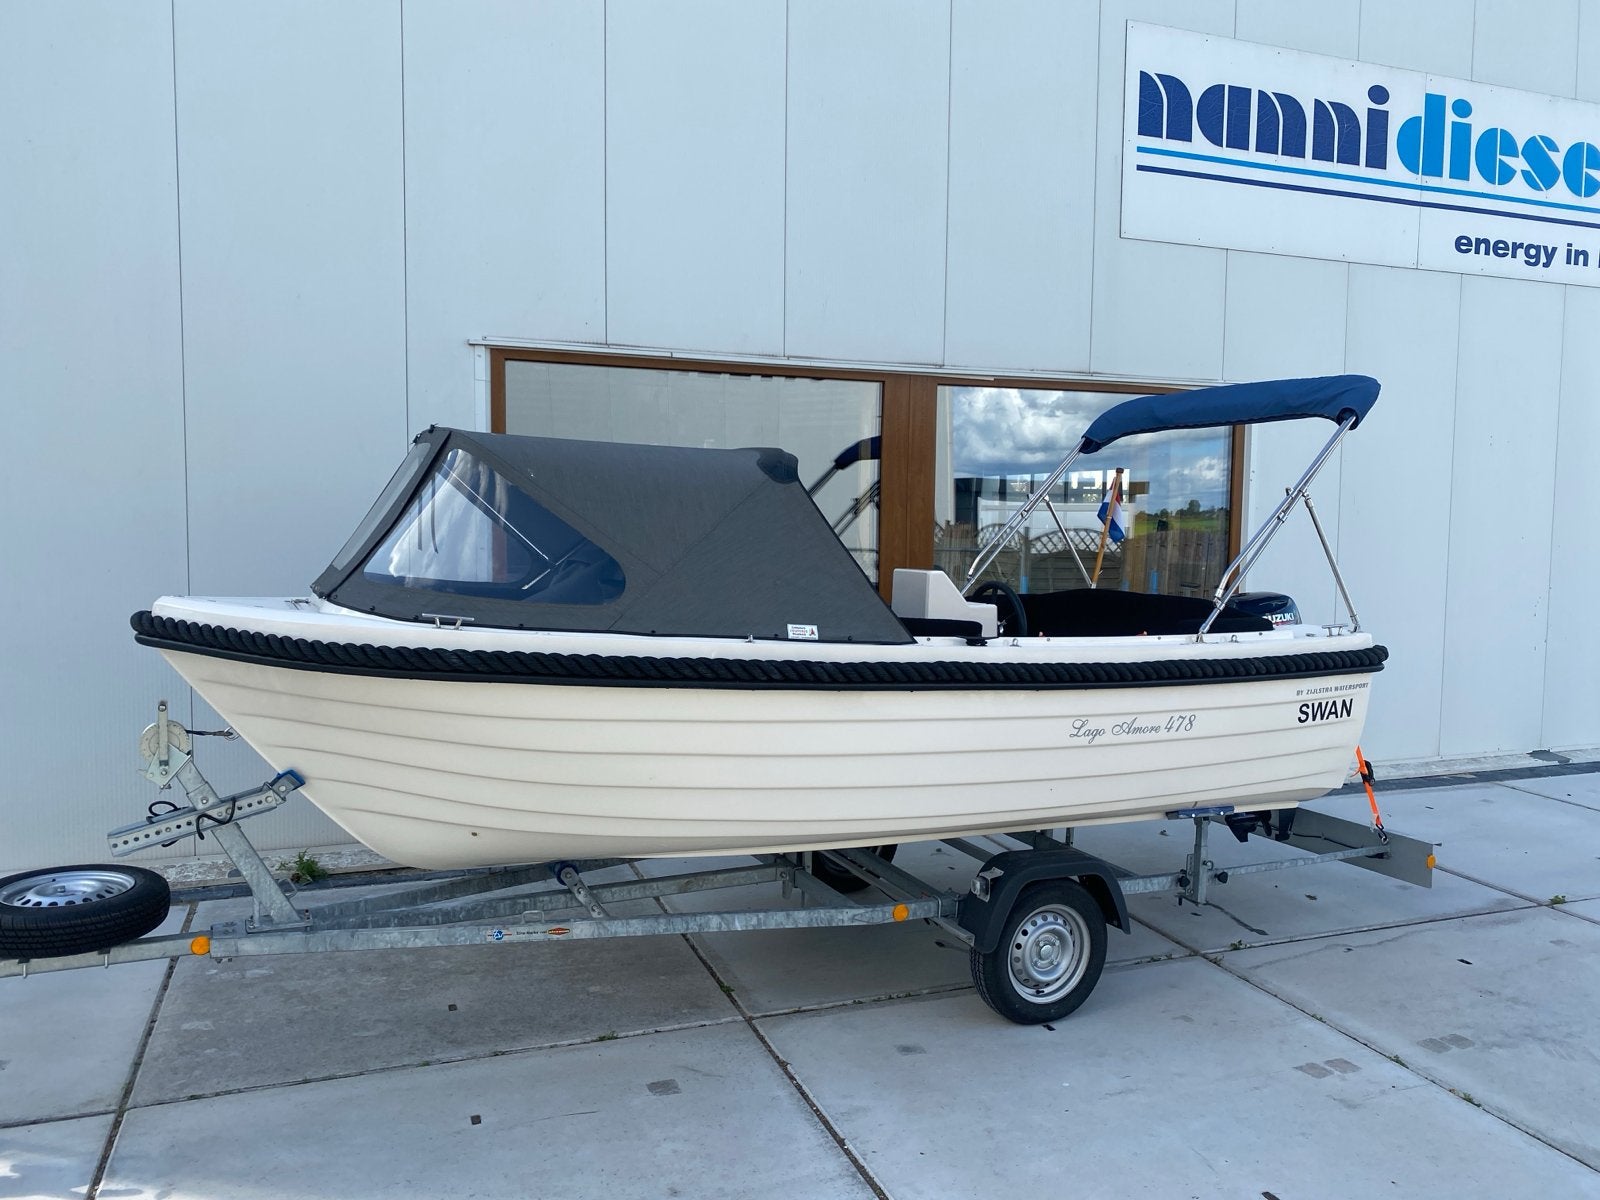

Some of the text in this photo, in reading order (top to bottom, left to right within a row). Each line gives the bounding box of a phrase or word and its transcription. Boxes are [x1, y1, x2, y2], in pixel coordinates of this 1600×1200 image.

[1454, 235, 1558, 268] energy
[1565, 242, 1589, 267] in
[1334, 682, 1369, 692] WATERSPORT
[1297, 698, 1354, 723] SWAN
[1069, 714, 1197, 744] Lago Amore 478
